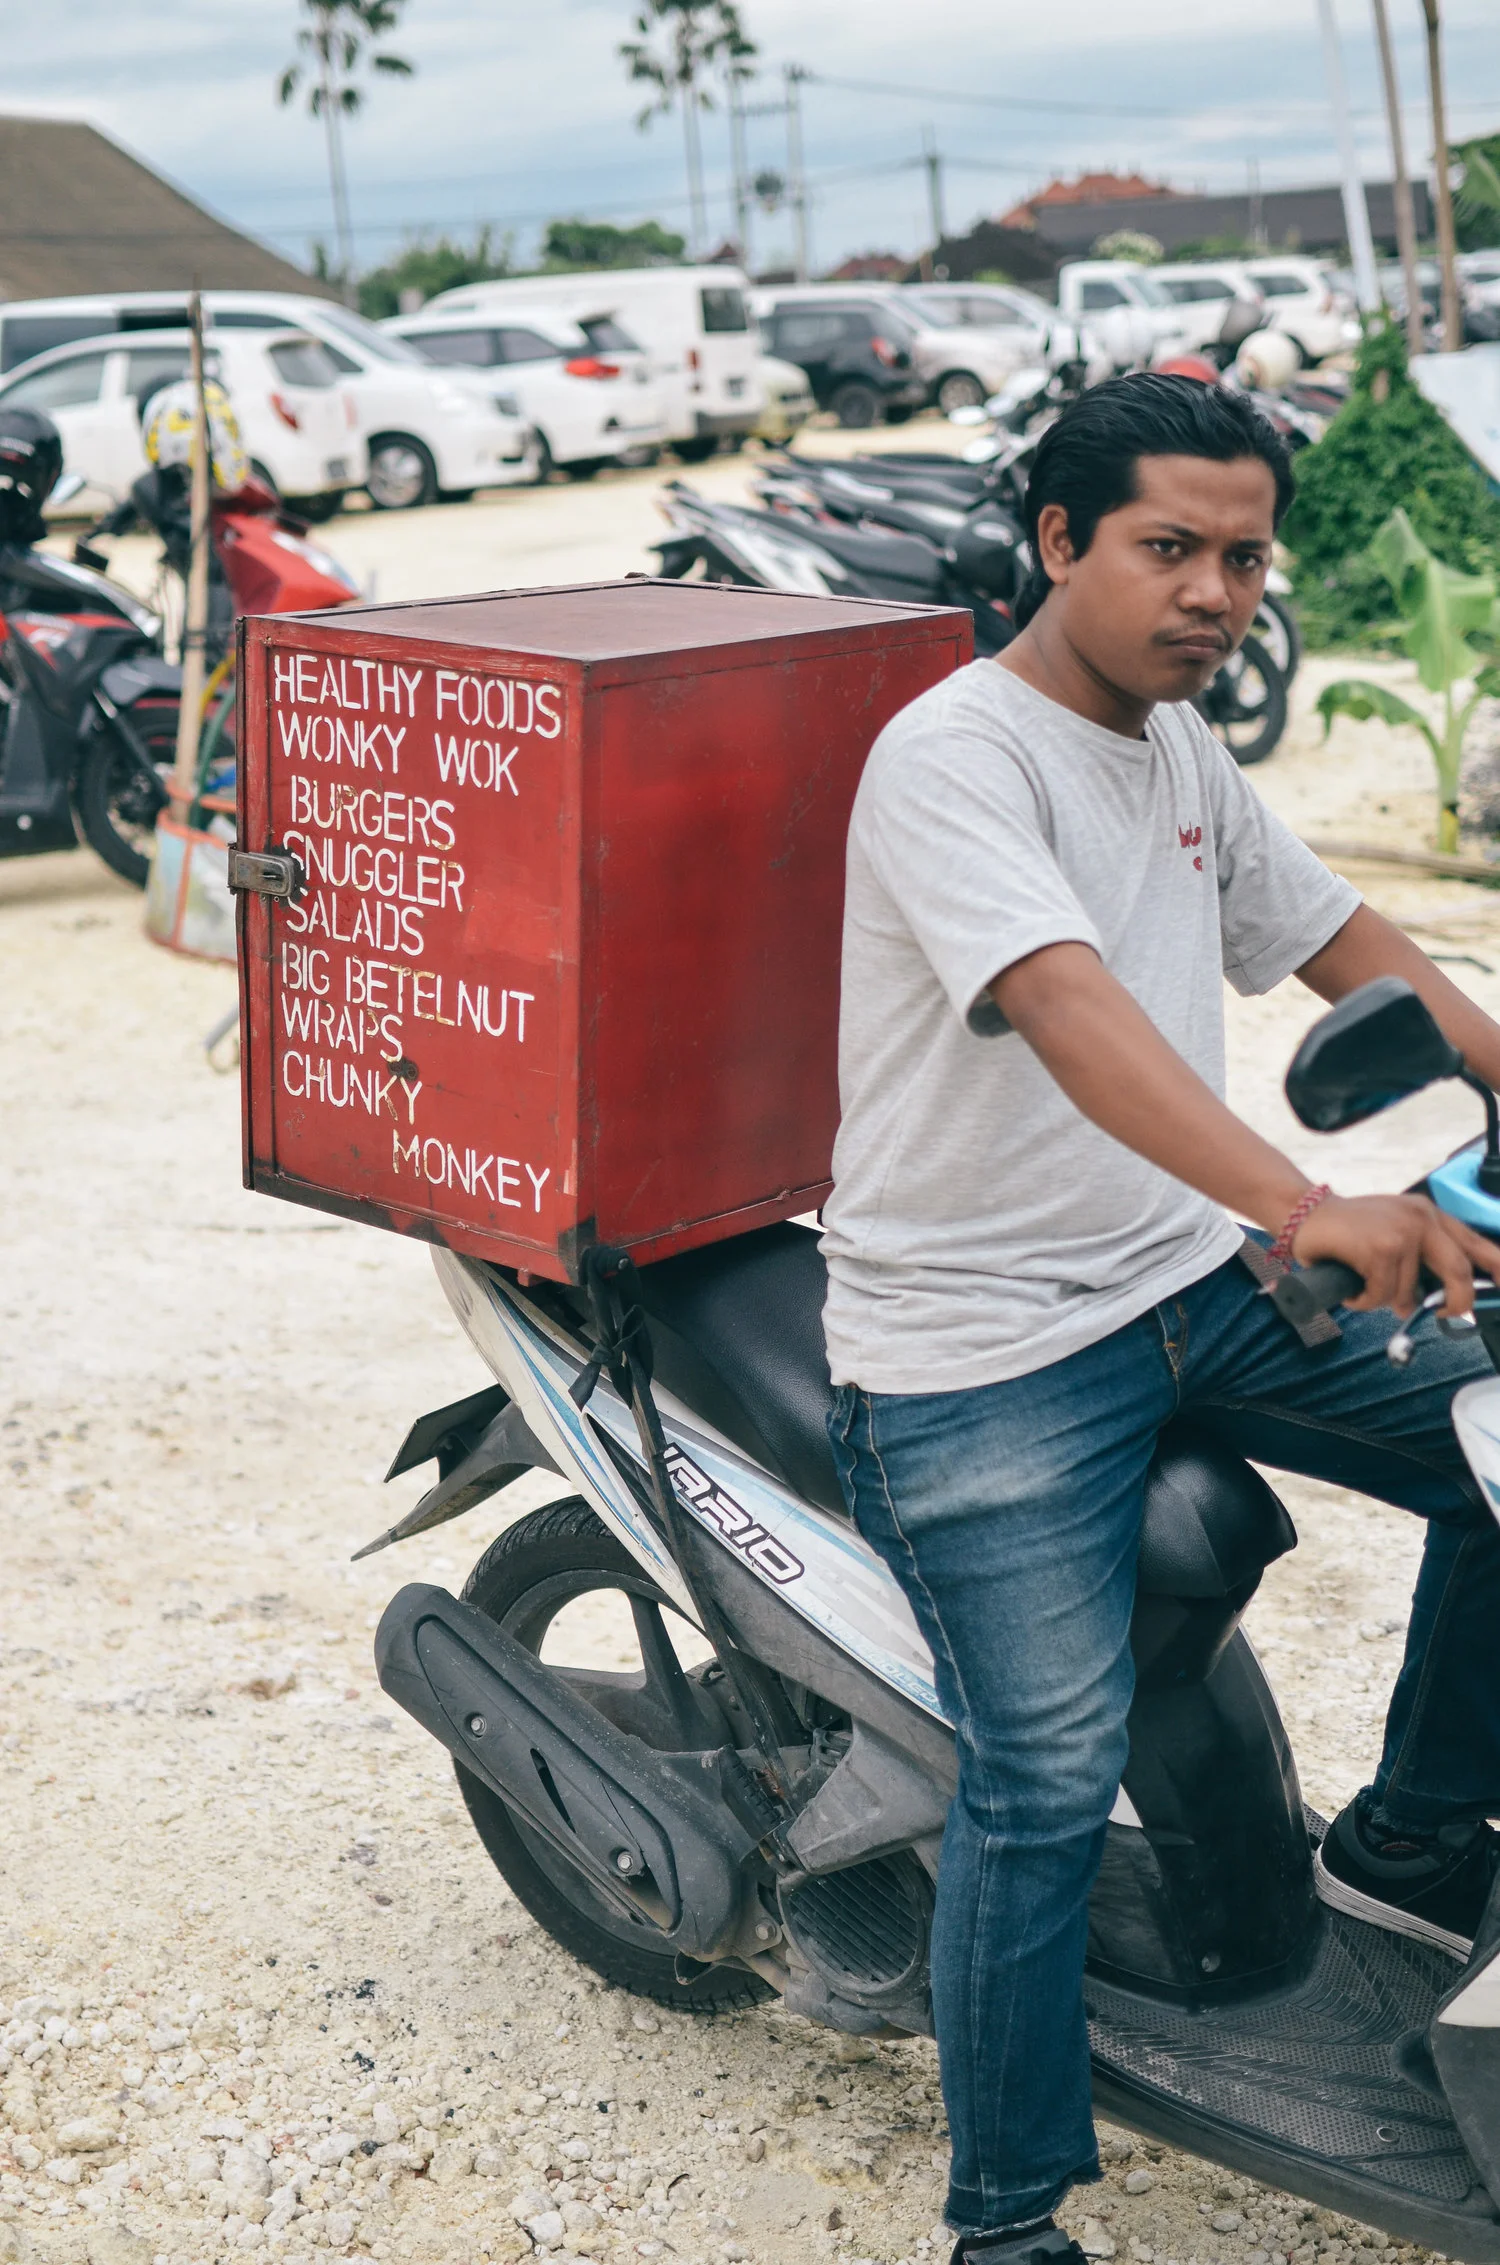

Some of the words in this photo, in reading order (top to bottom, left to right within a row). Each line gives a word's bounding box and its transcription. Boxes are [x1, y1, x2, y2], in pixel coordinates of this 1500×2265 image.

[274, 654, 423, 718] HEALTHY
[435, 670, 561, 739] FOODS
[277, 709, 407, 774] WONKY
[434, 732, 520, 797] WOK
[290, 774, 456, 851] BURGERS
[285, 889, 426, 957] SALADS
[280, 992, 403, 1063] WRAPS
[281, 941, 331, 996] BIG
[345, 954, 536, 1043] BETELNUT
[282, 1050, 423, 1125] CHUNKY
[392, 1128, 551, 1213] MONKEY
[662, 1442, 805, 1585] ARIO
